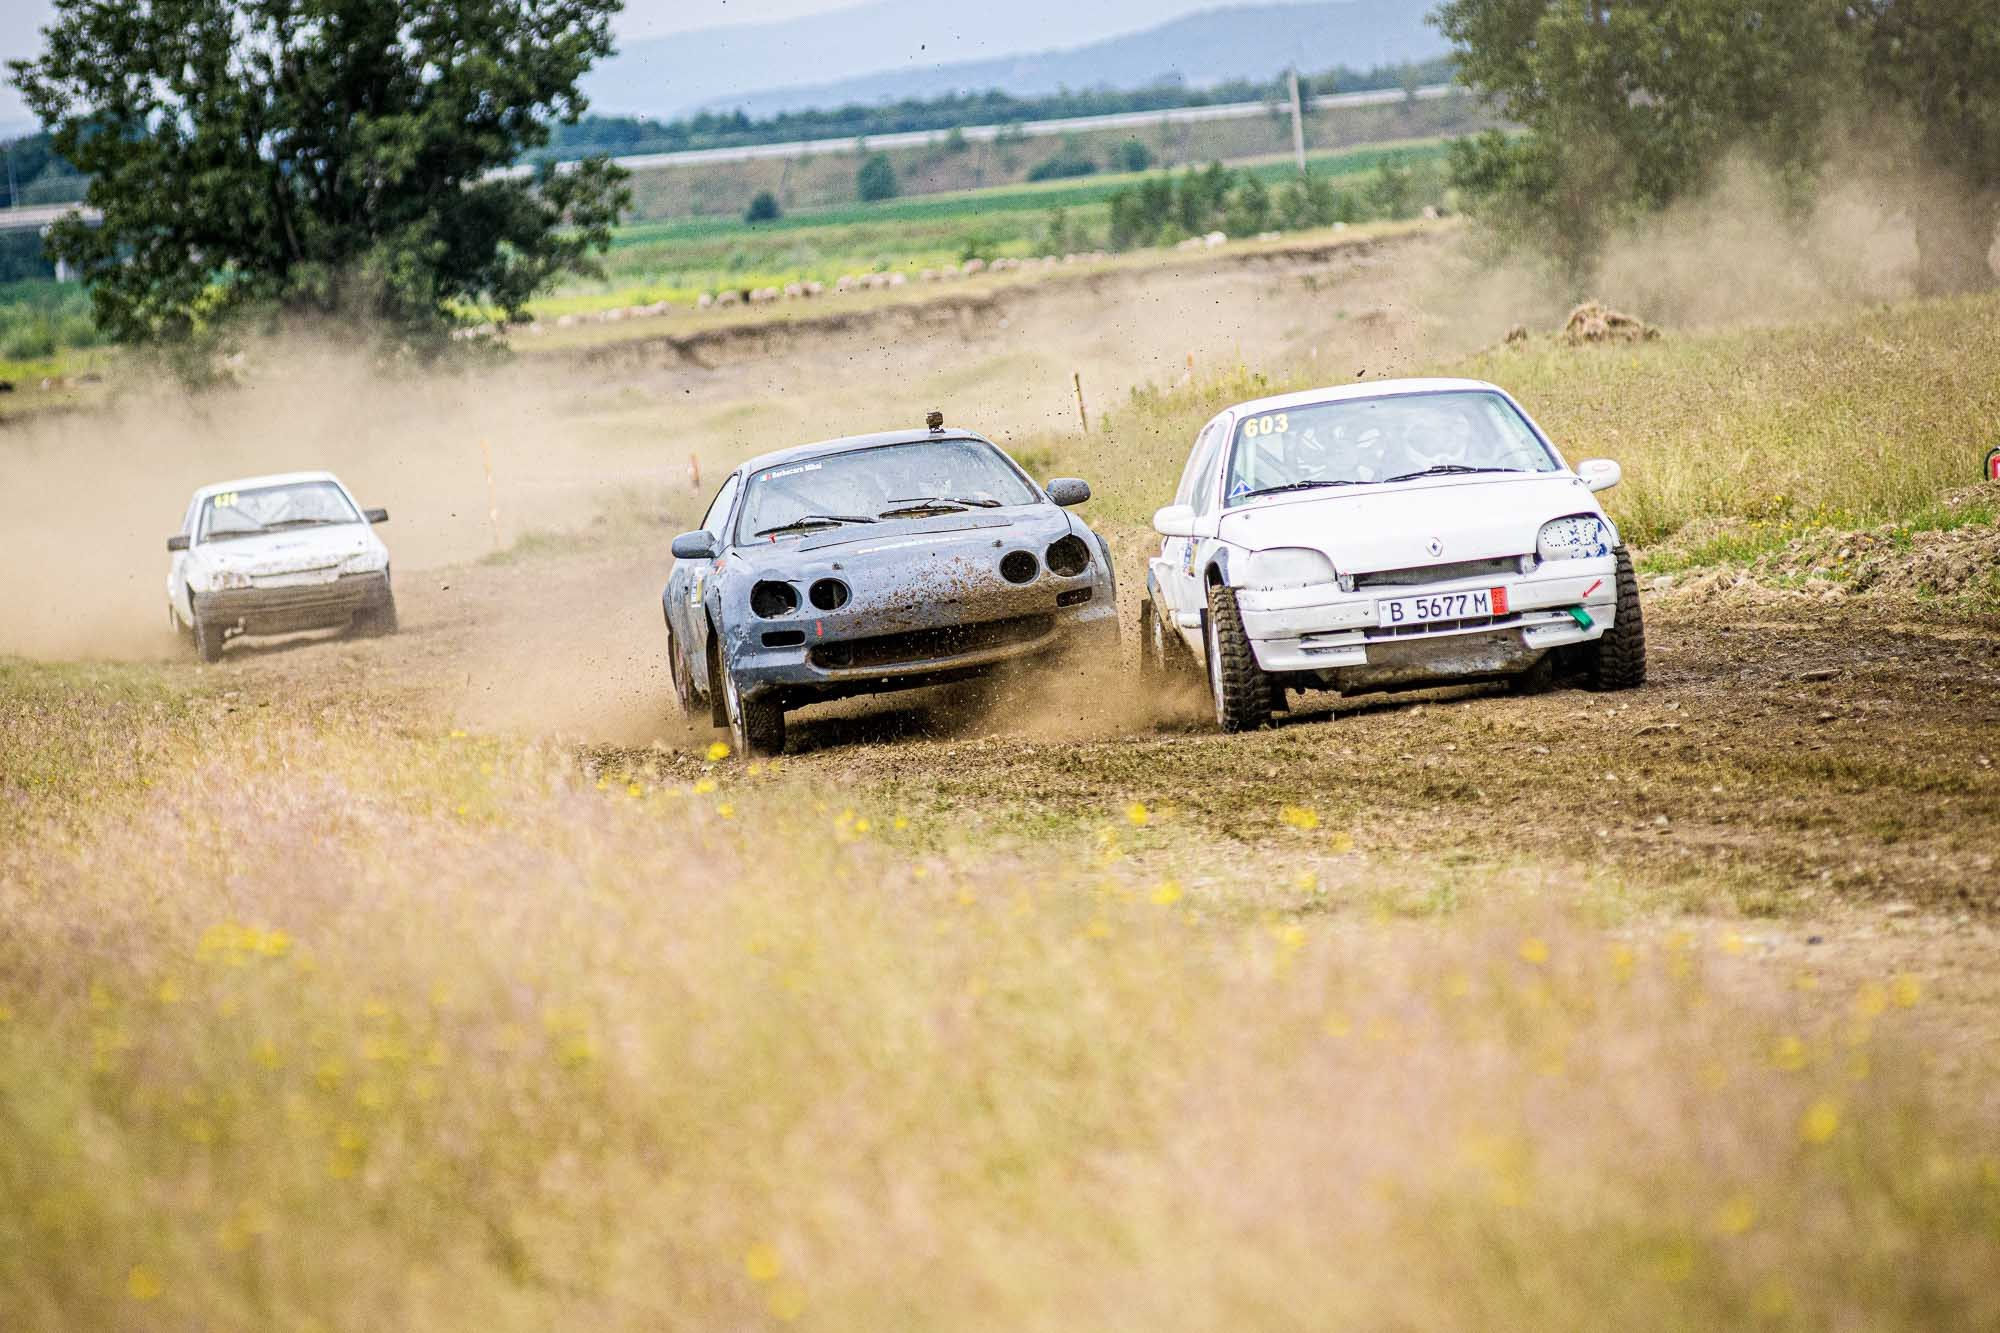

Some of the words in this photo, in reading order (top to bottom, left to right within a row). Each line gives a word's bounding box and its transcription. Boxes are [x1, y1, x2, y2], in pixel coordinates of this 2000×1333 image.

[1244, 413, 1289, 437] 603
[1390, 602, 1404, 622] B
[1416, 594, 1468, 619] 5677
[1474, 592, 1489, 614] M
